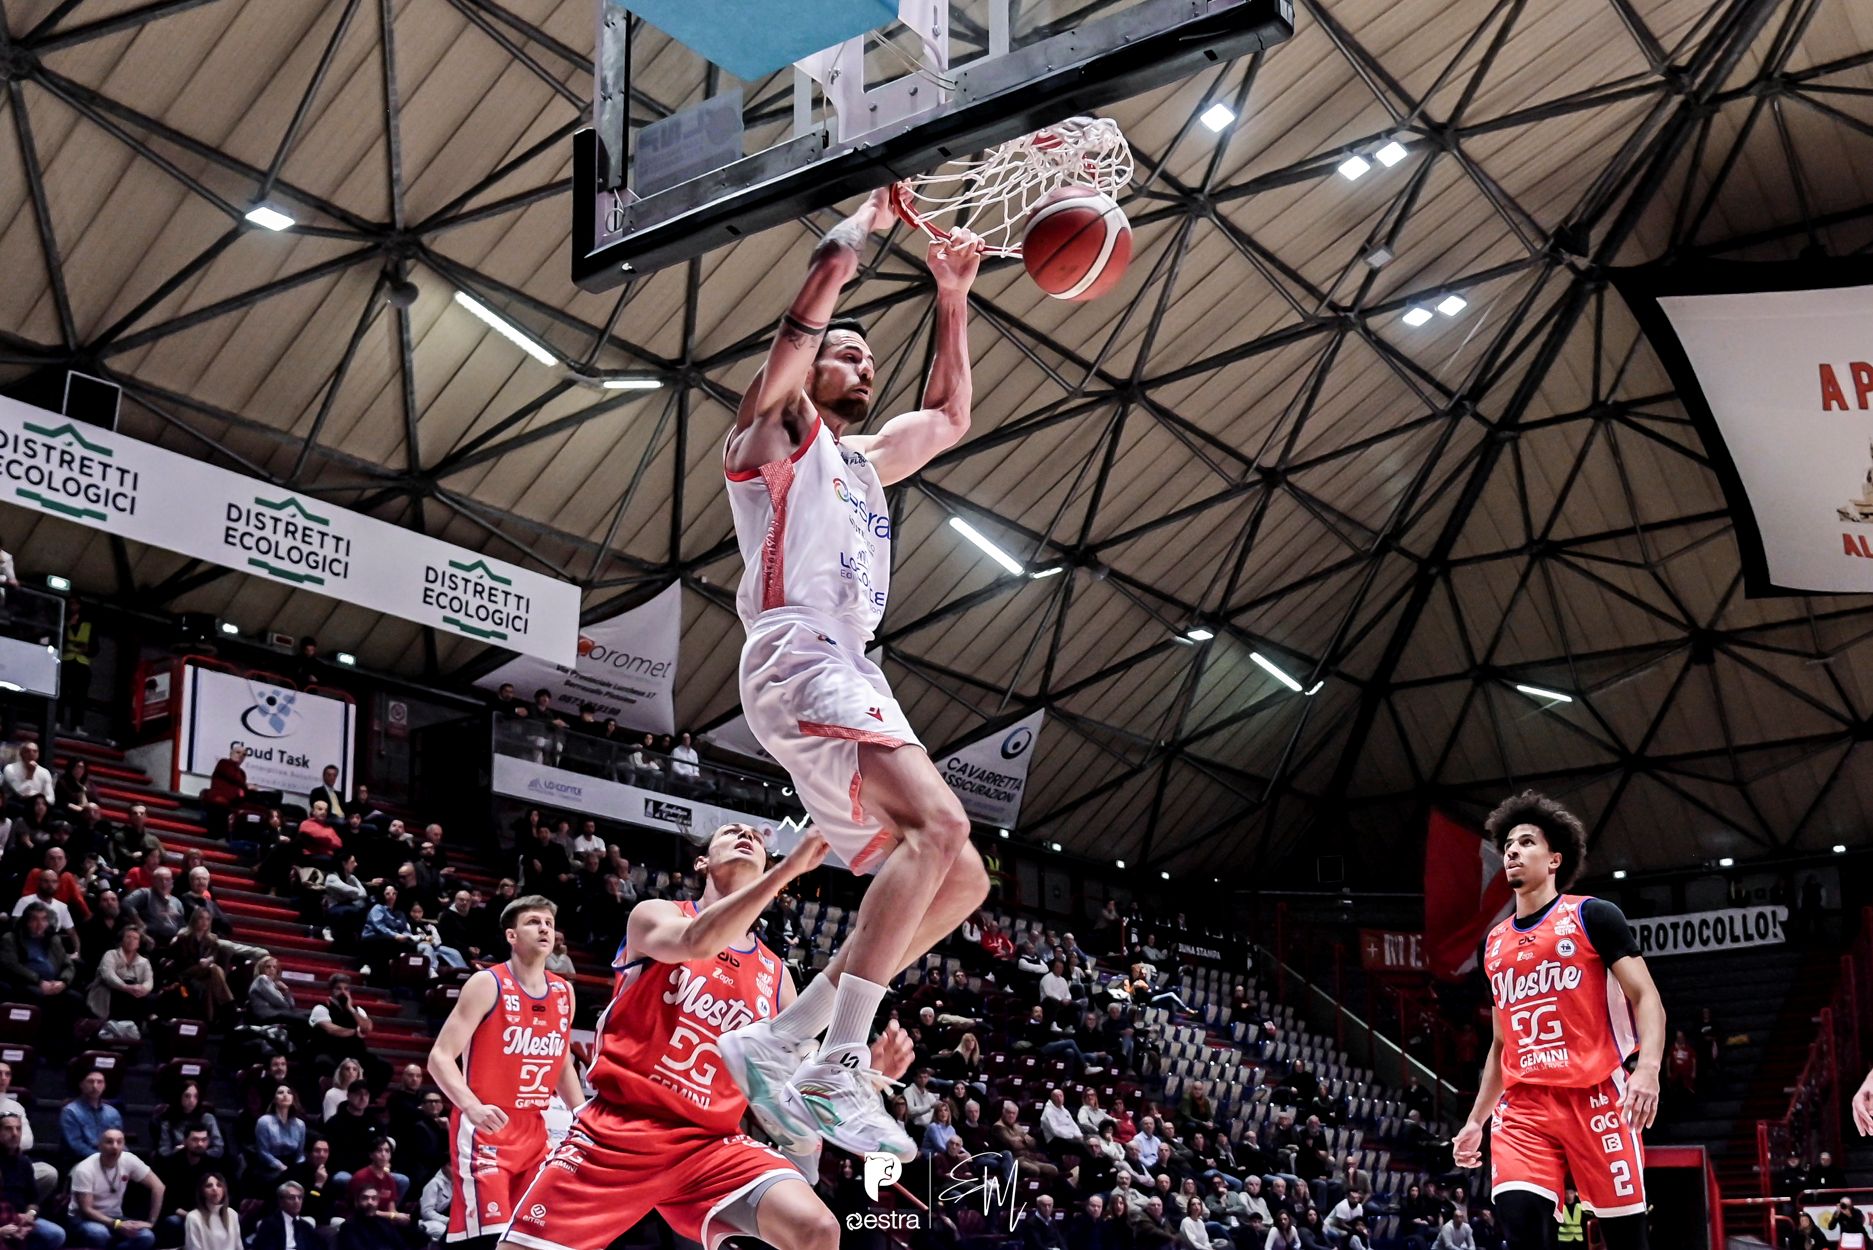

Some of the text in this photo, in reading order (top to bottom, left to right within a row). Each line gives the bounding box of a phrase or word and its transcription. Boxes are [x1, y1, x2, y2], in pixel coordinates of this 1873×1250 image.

[0, 455, 136, 515] COLOGICI
[226, 502, 351, 557] DISTRETTI
[224, 525, 349, 579] ECOLOGICI
[422, 586, 529, 635] ECOLOGICI
[425, 565, 530, 614] DISTRETTI
[278, 749, 310, 769] Task
[946, 757, 1024, 792] CAVARRETTA
[1491, 939, 1502, 958] 2
[712, 967, 734, 986] Zago
[1491, 959, 1582, 1010] Mestre
[503, 994, 520, 1012] 35
[663, 965, 755, 1033] Mestr
[1520, 1048, 1569, 1068] GEMINI
[1609, 1159, 1635, 1198] 2
